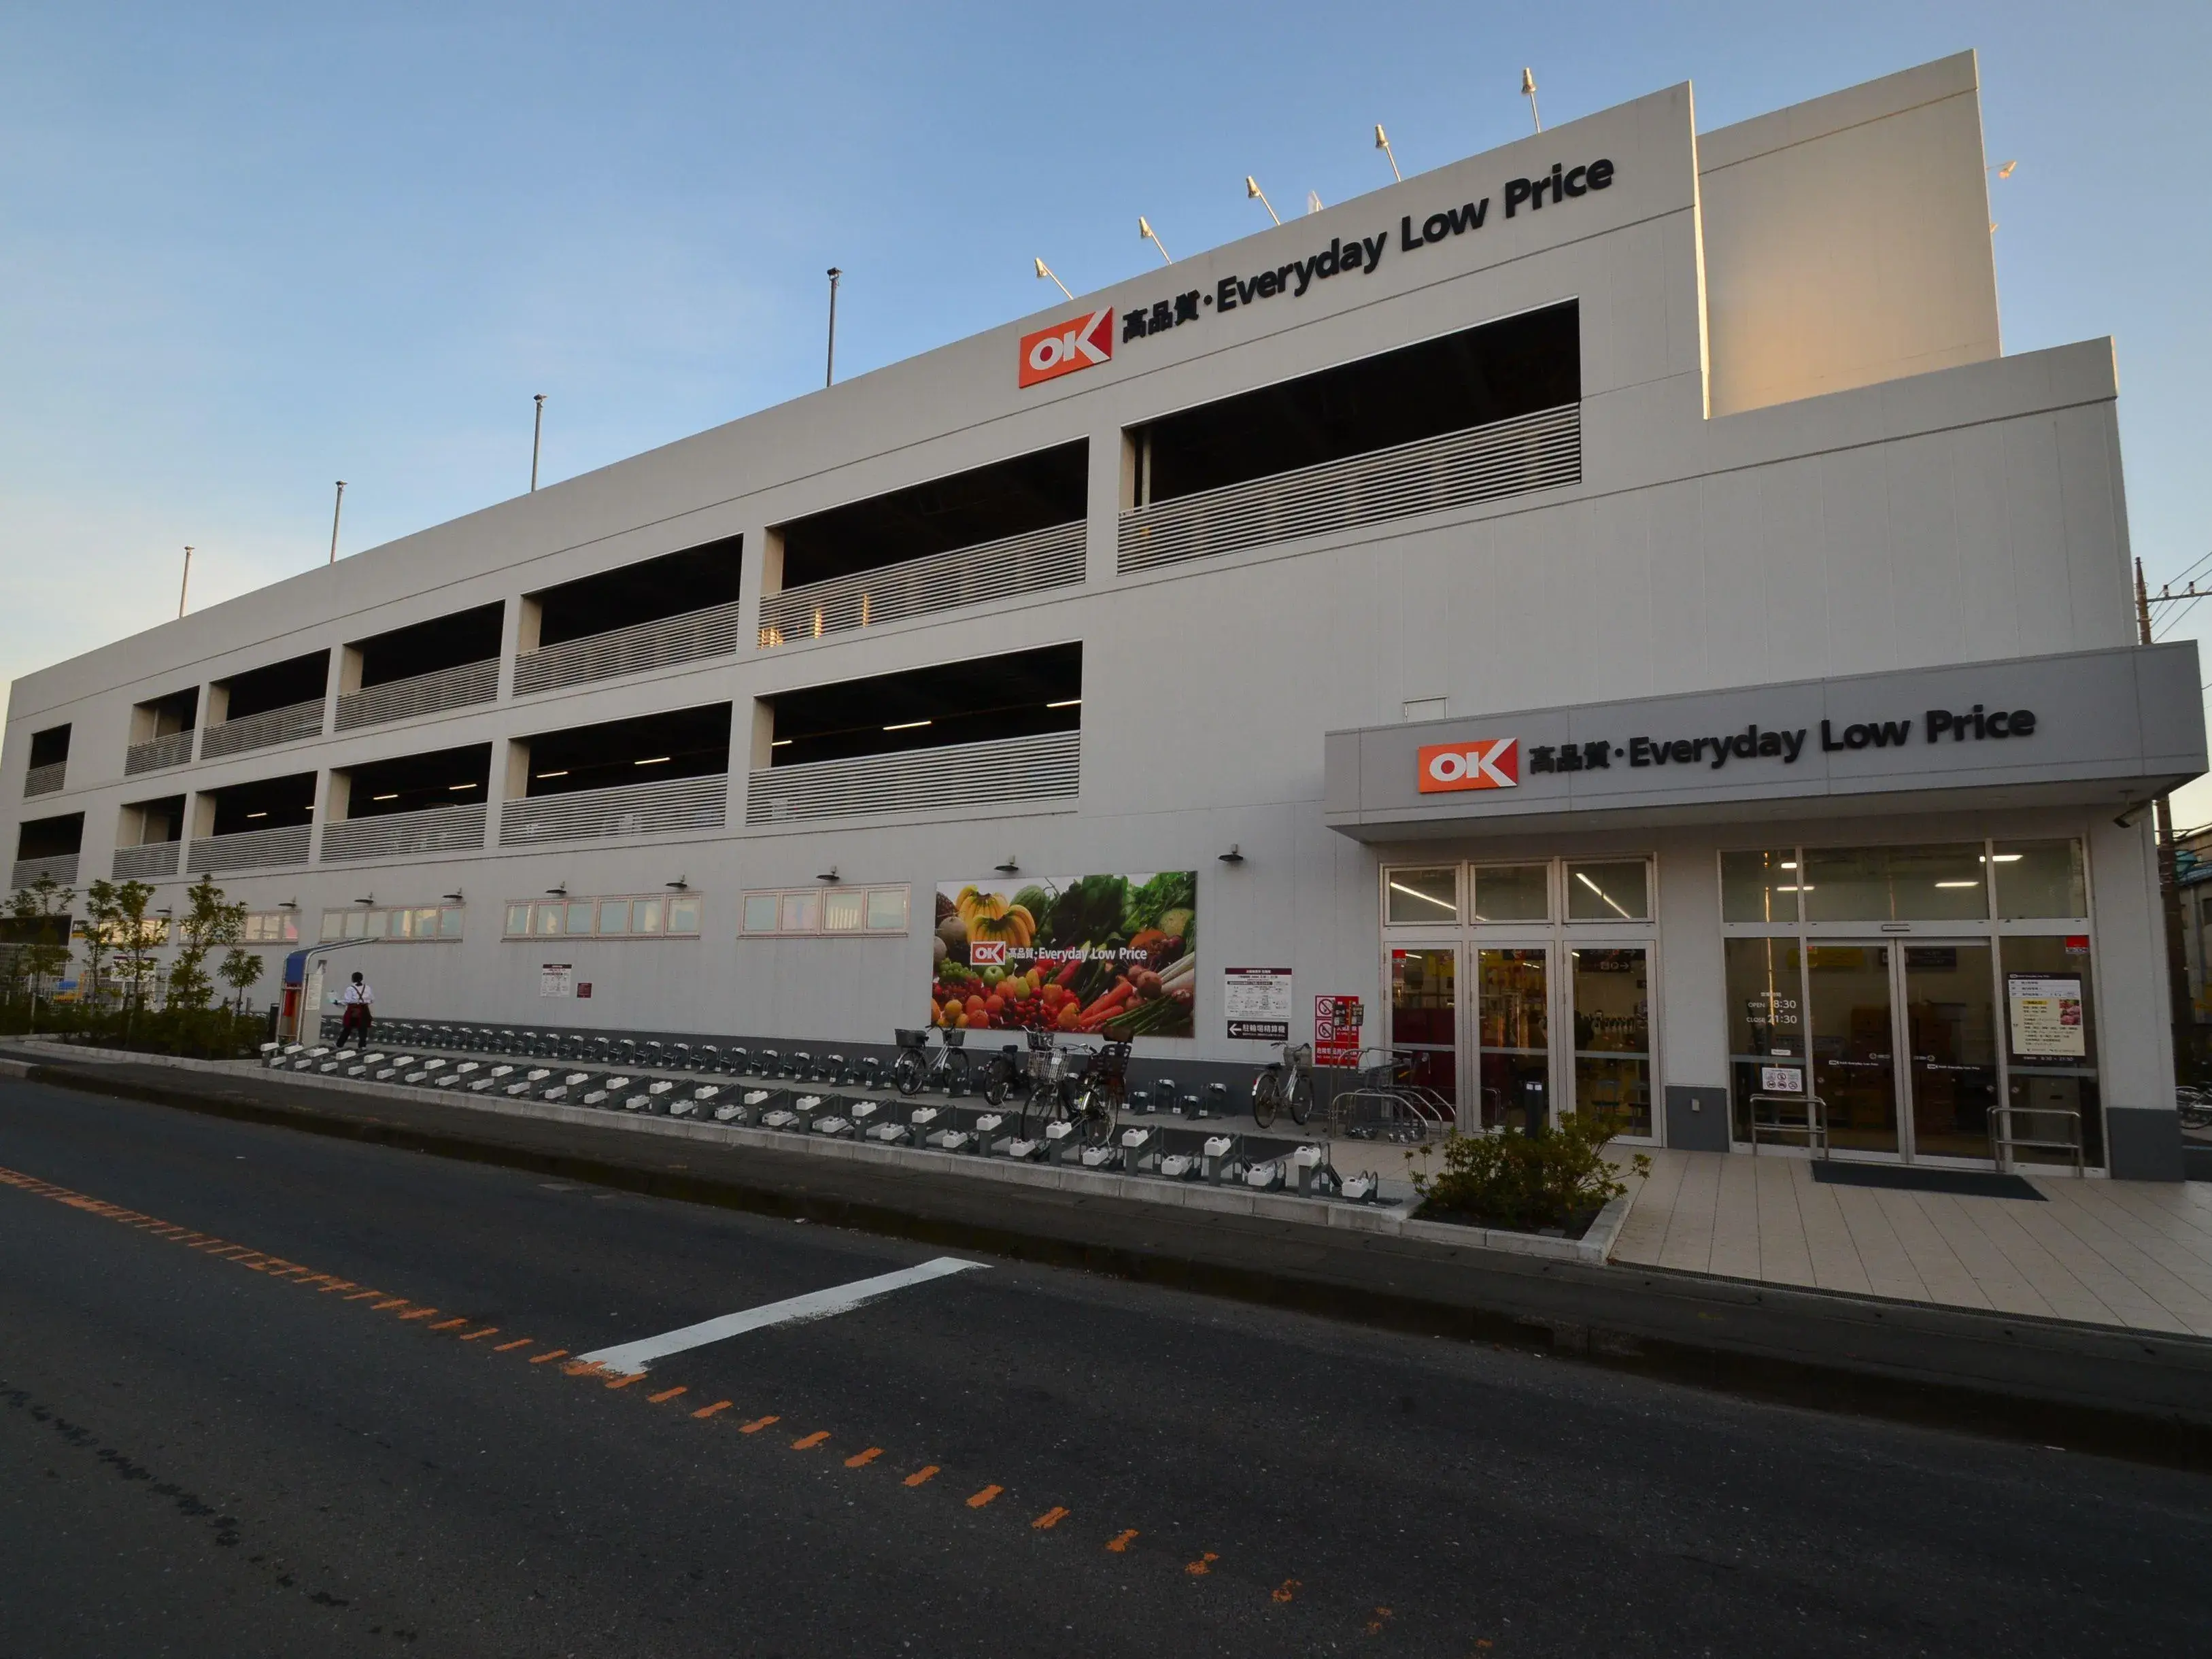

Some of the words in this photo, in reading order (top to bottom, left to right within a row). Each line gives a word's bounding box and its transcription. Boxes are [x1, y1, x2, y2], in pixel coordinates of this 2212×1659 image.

[1029, 305, 1113, 371] OK
[1217, 231, 1388, 313] Everyday
[1401, 196, 1490, 252] Low
[1504, 158, 1614, 218] Price
[1429, 738, 1517, 787] OK
[1629, 724, 1807, 769] Everyday
[1821, 719, 1911, 751] Low
[1926, 704, 2036, 743] Price
[975, 942, 1005, 965] OK
[1091, 947, 1115, 960] Low
[1119, 947, 1146, 959] Price
[1773, 999, 1797, 1008] 8:30
[1767, 1014, 1797, 1024] 21:30
